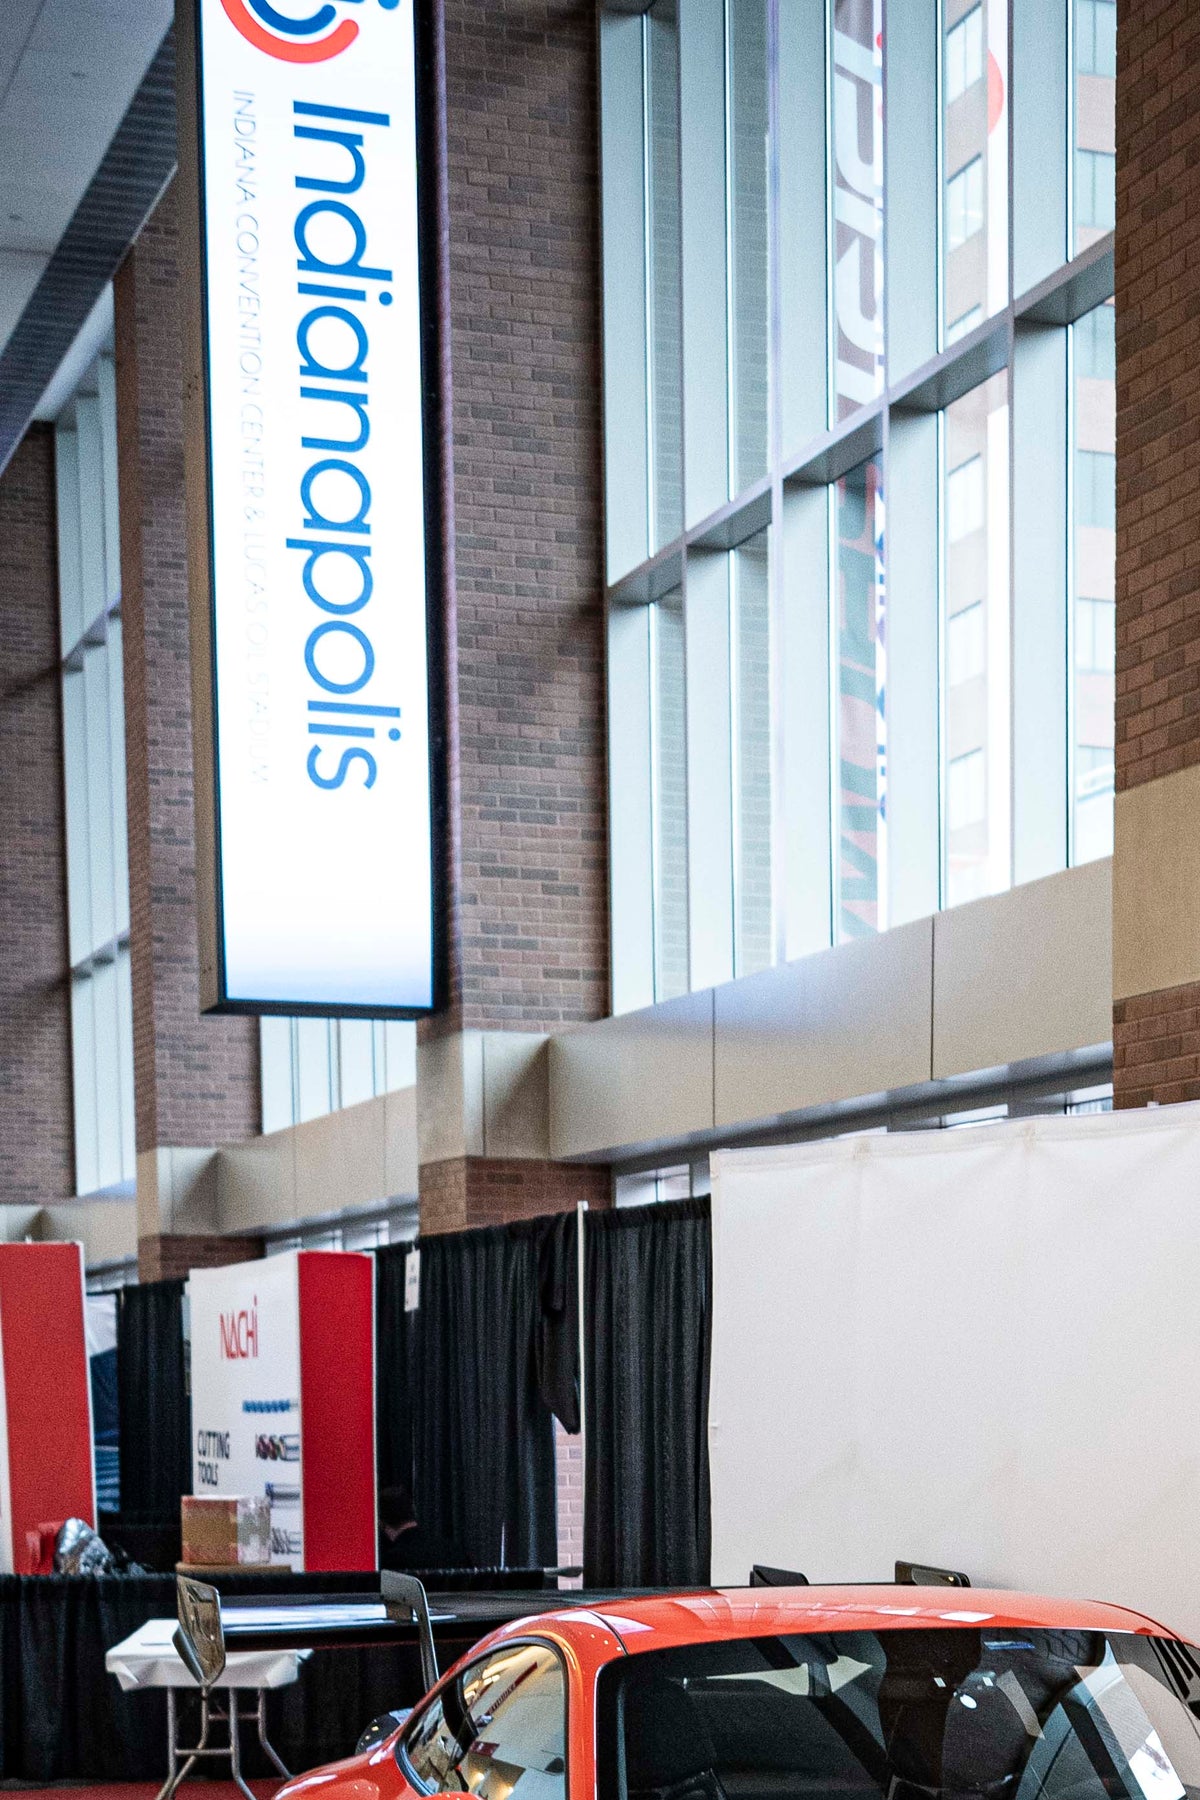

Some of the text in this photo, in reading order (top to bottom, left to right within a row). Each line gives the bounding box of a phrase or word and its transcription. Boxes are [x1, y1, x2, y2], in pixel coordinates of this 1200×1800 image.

[233, 90, 257, 206] INDIANA
[235, 214, 262, 393] CONVENTION
[240, 403, 264, 498] CENTER
[286, 100, 401, 790] Indianapolis
[243, 532, 268, 613] LUCAS
[198, 1430, 230, 1460] CUTTING
[198, 1461, 219, 1486] TOOLS
